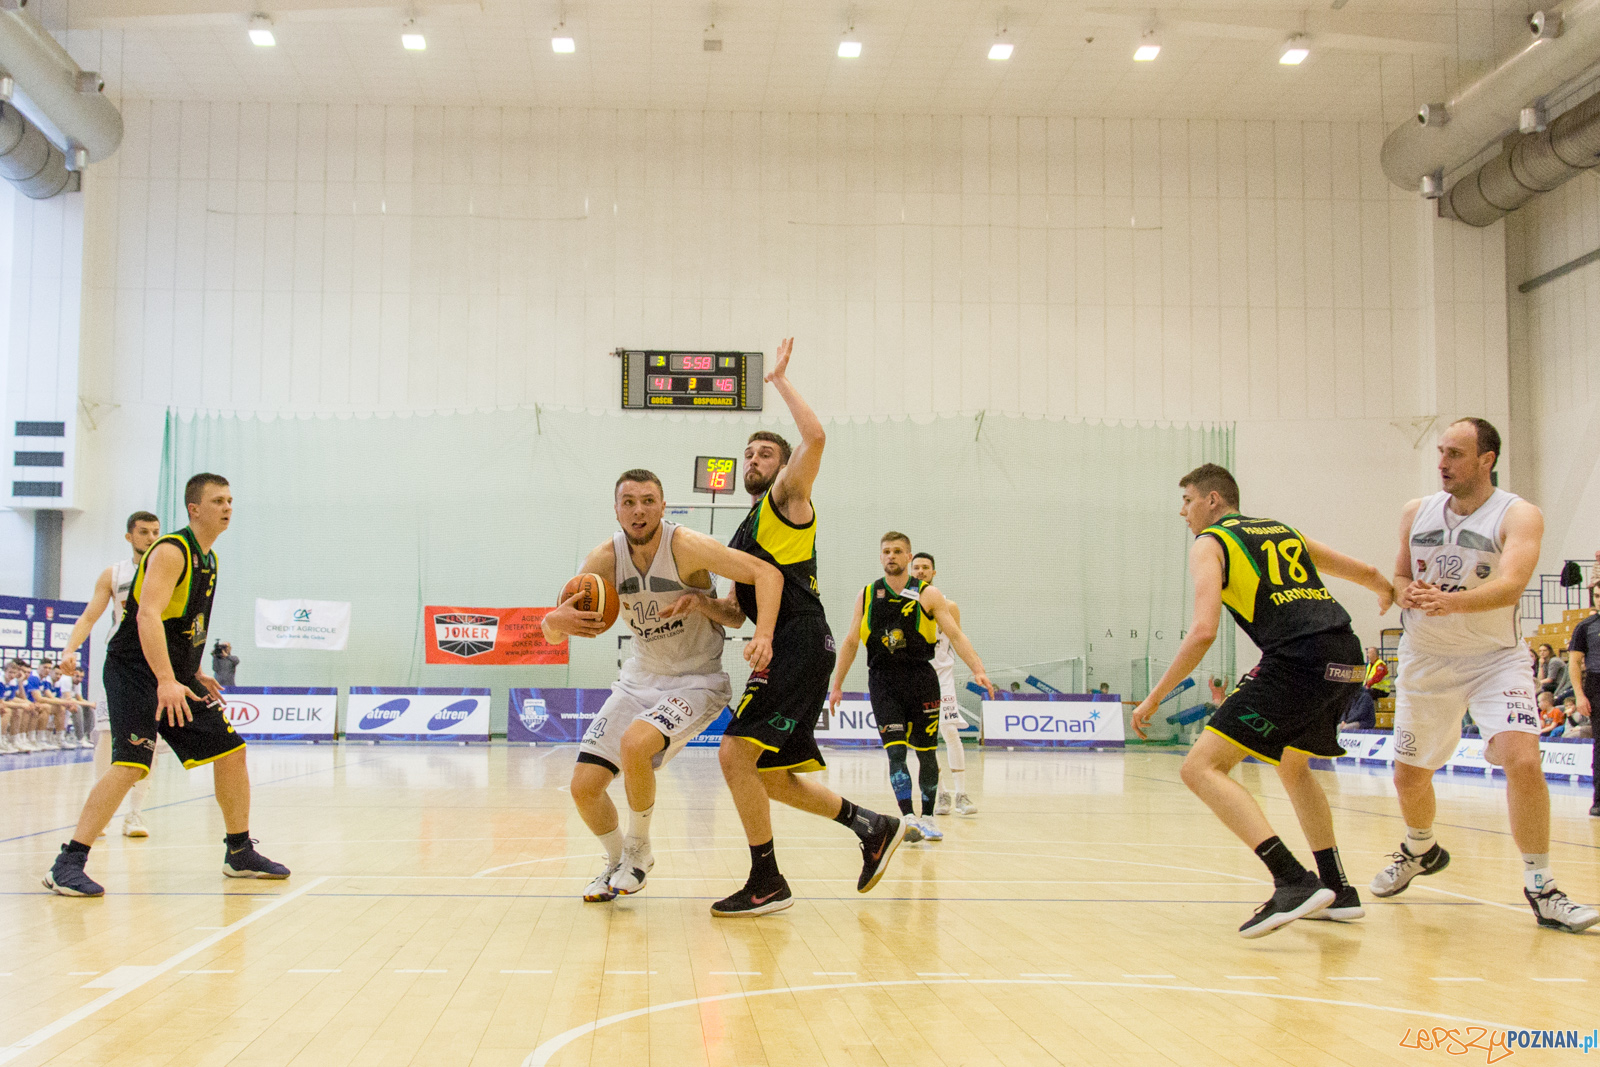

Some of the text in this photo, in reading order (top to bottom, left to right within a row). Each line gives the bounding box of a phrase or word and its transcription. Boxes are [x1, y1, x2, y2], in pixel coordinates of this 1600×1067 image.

[725, 357, 729, 367] 1
[654, 378, 733, 391] 41 3 46
[651, 396, 733, 405] GOŚCIE GOSPODARZE
[707, 458, 733, 473] 5:58
[710, 471, 726, 488] 16
[1261, 538, 1308, 585] 18
[1435, 554, 1463, 580] 12
[632, 600, 661, 625] 14
[901, 600, 916, 617] 4
[296, 625, 337, 634] AGRICOLE
[444, 626, 490, 640] JOKER
[1105, 628, 1164, 640] A B C
[366, 706, 401, 720] atrem
[671, 697, 690, 714] KIA
[272, 707, 322, 721] DELIK
[434, 708, 469, 721] atrem
[657, 704, 684, 725] DELIK
[1517, 712, 1538, 728] PBG
[925, 719, 939, 737] 4
[1004, 714, 1096, 733] POZnan
[1395, 726, 1417, 752] 12
[1546, 751, 1576, 766] NICKEL
